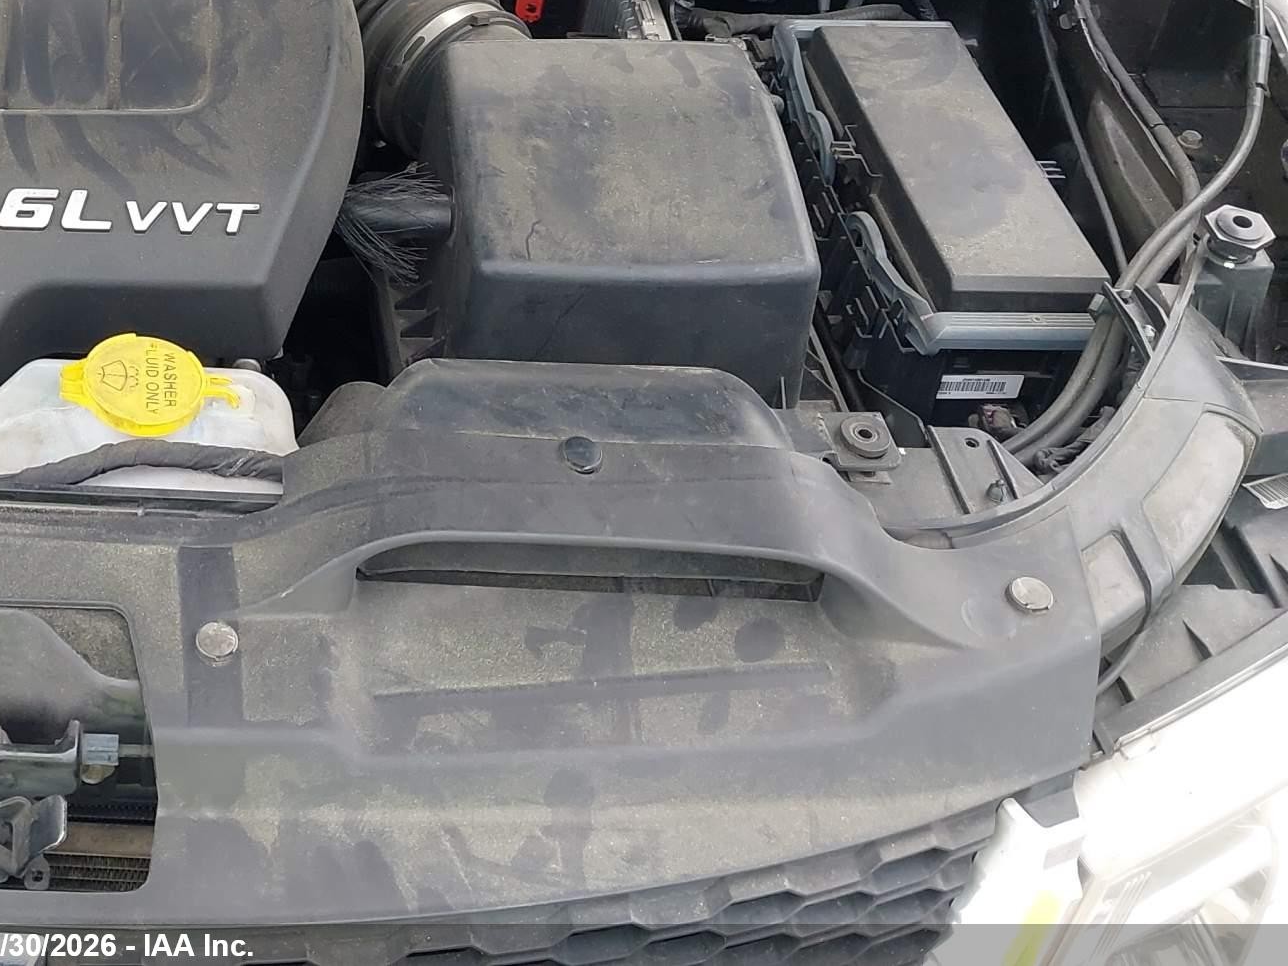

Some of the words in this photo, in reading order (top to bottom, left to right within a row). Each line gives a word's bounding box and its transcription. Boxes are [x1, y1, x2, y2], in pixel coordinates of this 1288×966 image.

[125, 200, 261, 235] VVT
[145, 342, 158, 378] FLUID
[164, 352, 177, 407] WASHER
[145, 382, 158, 415] ONLY
